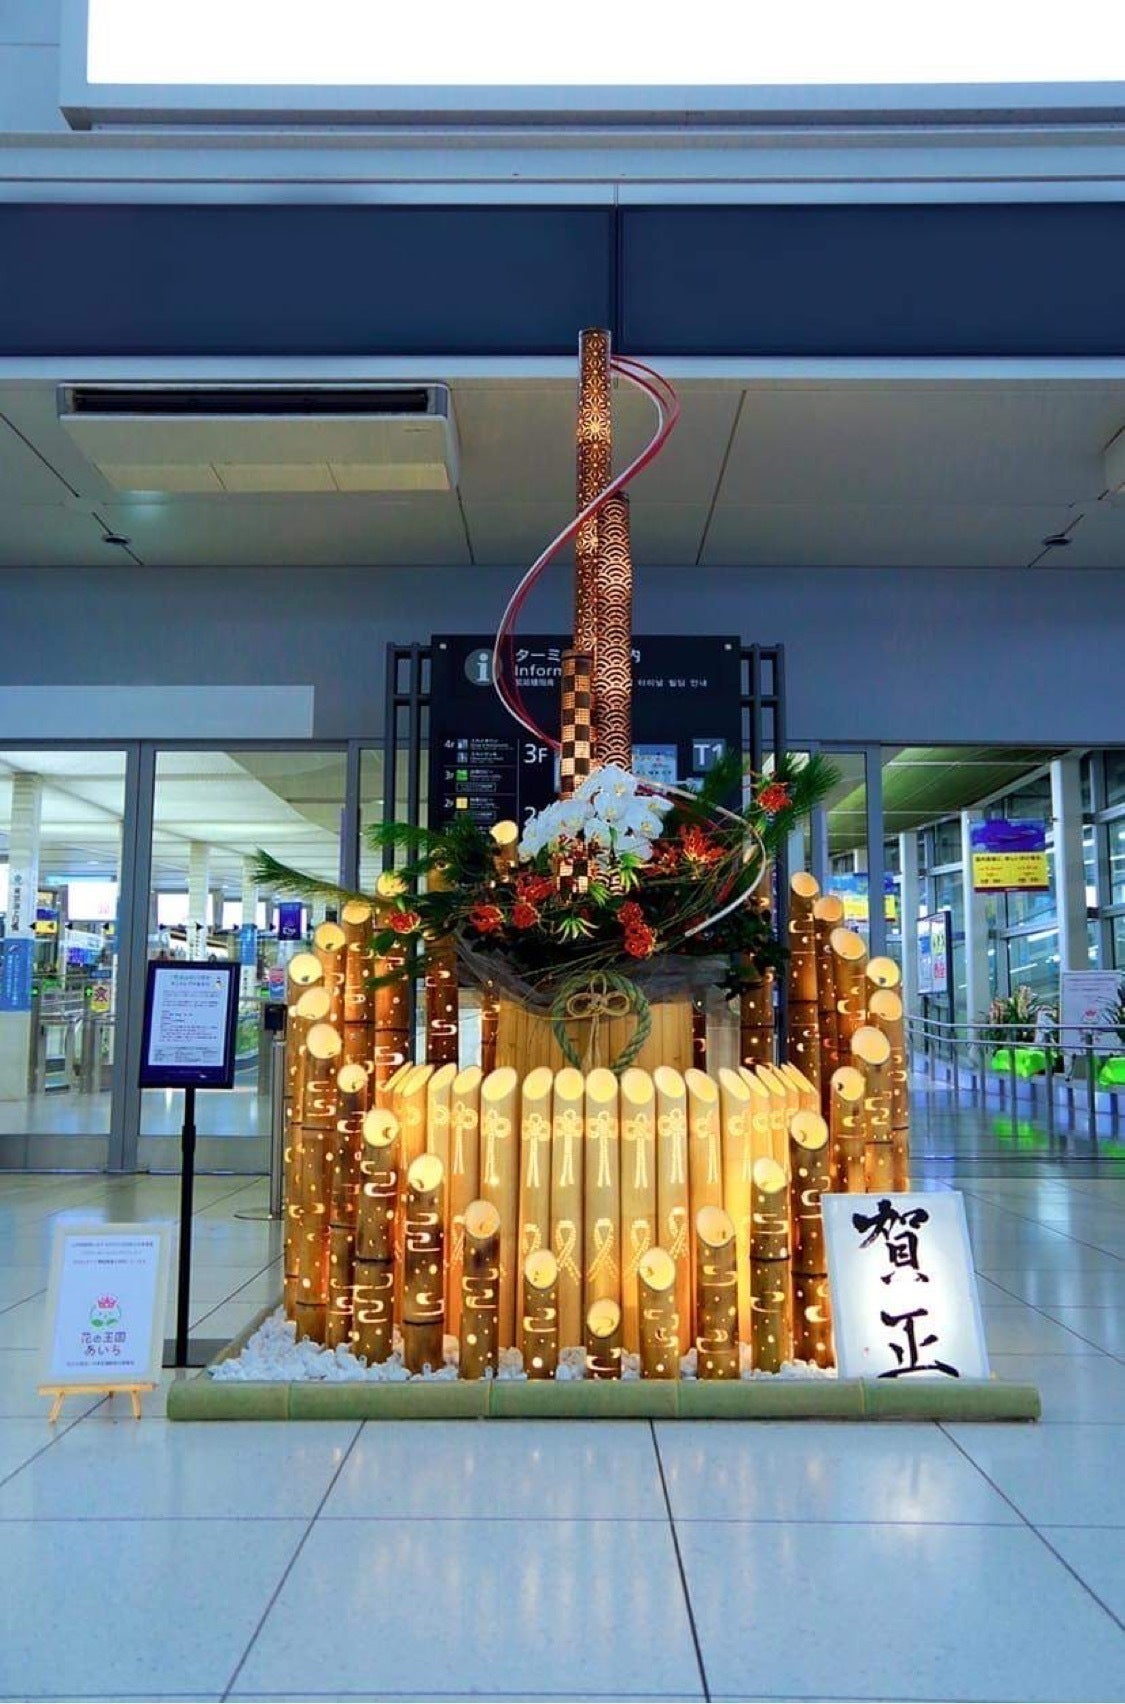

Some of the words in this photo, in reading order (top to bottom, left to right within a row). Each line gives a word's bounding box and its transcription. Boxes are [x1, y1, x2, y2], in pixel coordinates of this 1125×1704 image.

[524, 743, 549, 763] 3F
[693, 743, 724, 766] T1
[852, 1198, 960, 1379] 賀正
[81, 1331, 127, 1344] 花の王国
[84, 1344, 122, 1357] あいち
